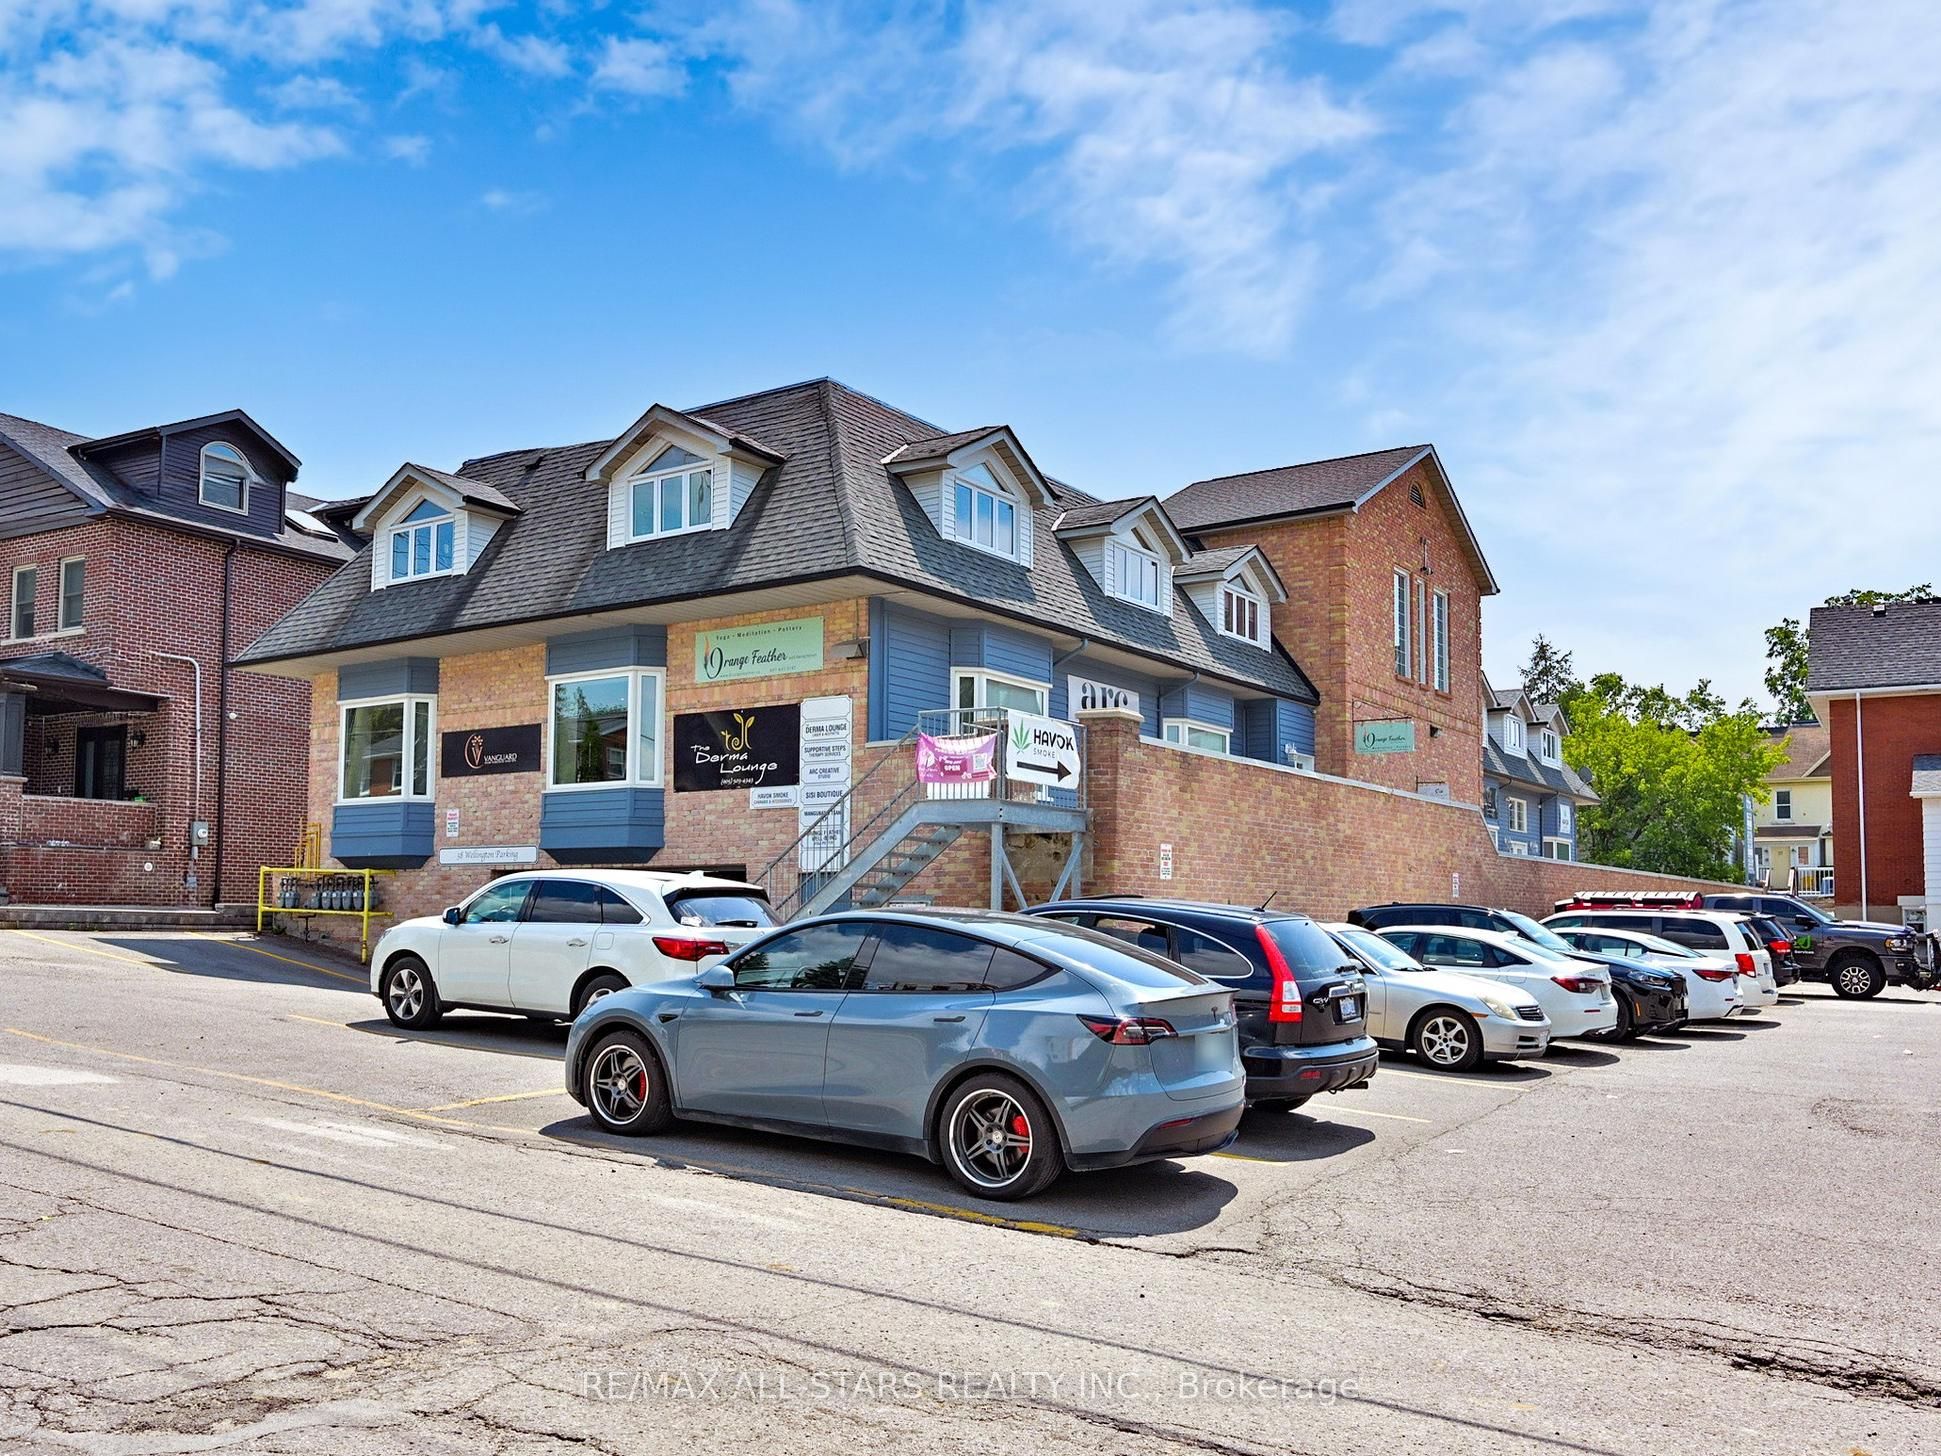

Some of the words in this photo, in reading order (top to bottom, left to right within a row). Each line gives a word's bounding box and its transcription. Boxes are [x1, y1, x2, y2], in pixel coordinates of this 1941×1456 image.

[737, 629, 771, 638] Meditation
[704, 646, 749, 679] Orange
[751, 647, 788, 665] Feather
[805, 725, 825, 734] DERMA
[825, 723, 847, 732] LOUNGE
[1033, 728, 1074, 751] HAVOK
[483, 752, 518, 762] VANGUARD
[695, 751, 749, 764] Derma
[1033, 748, 1056, 759] SMOKE
[720, 762, 778, 785] Lounge
[816, 789, 843, 798] BOUTIQUE
